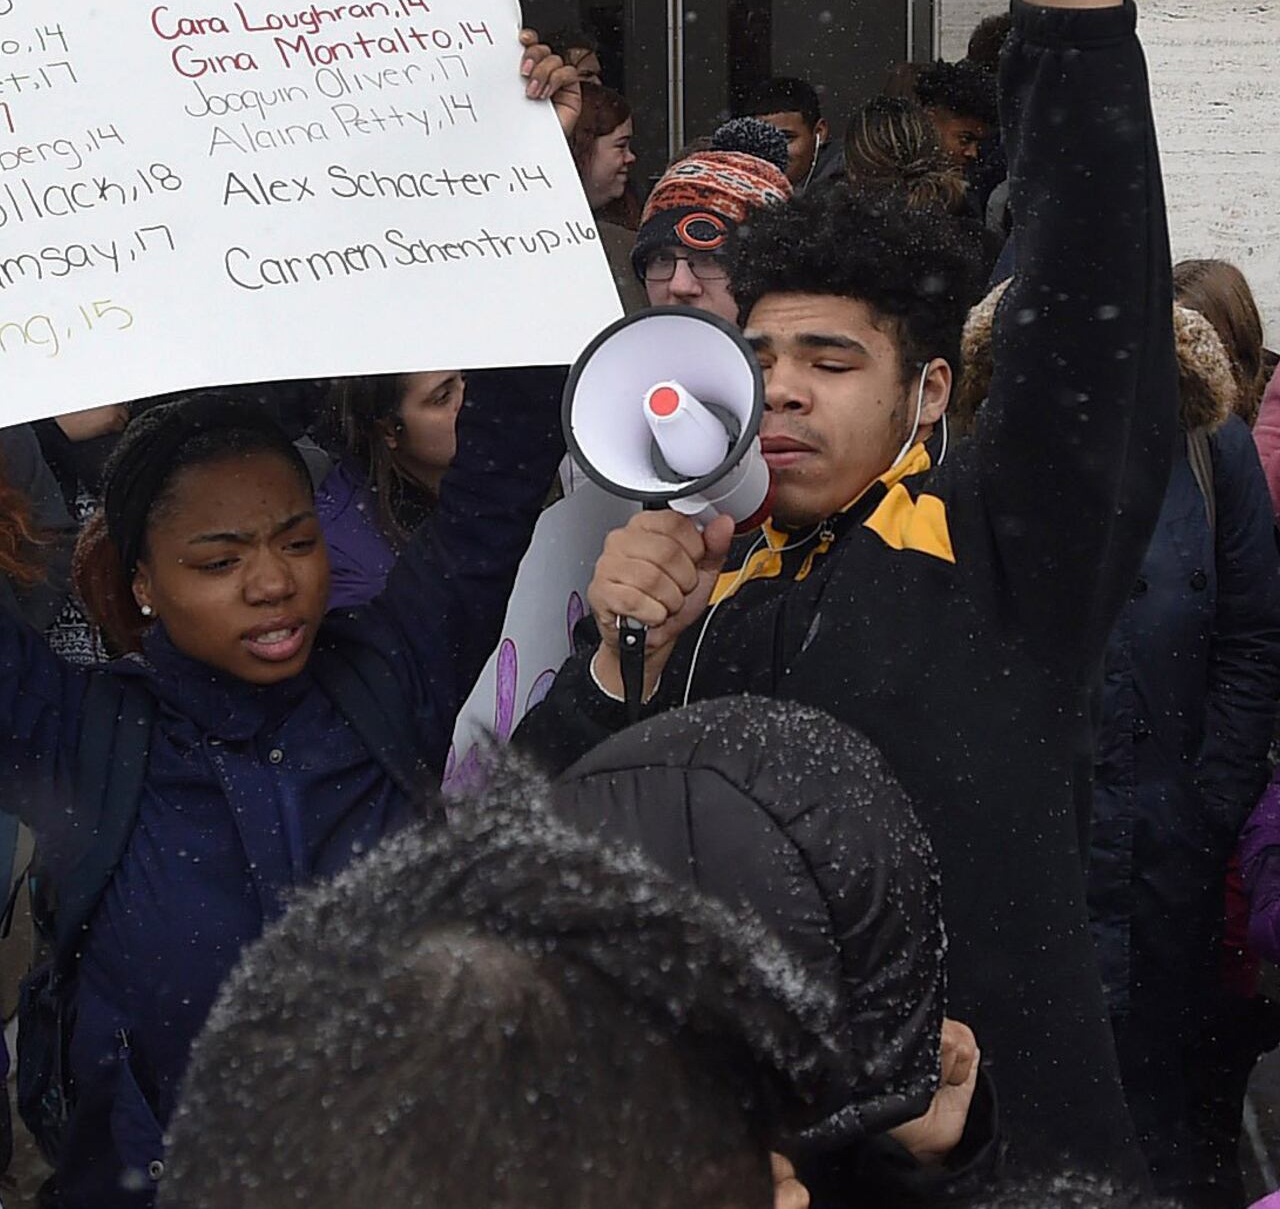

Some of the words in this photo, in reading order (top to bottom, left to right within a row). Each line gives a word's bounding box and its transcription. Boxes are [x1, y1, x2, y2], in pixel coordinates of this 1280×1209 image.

[150, 5, 230, 41] Cara
[170, 44, 259, 79] Gina
[184, 78, 309, 119] Joaquin
[207, 112, 329, 157] Alaina
[222, 171, 316, 207] Alex
[223, 241, 389, 291] Carmen
